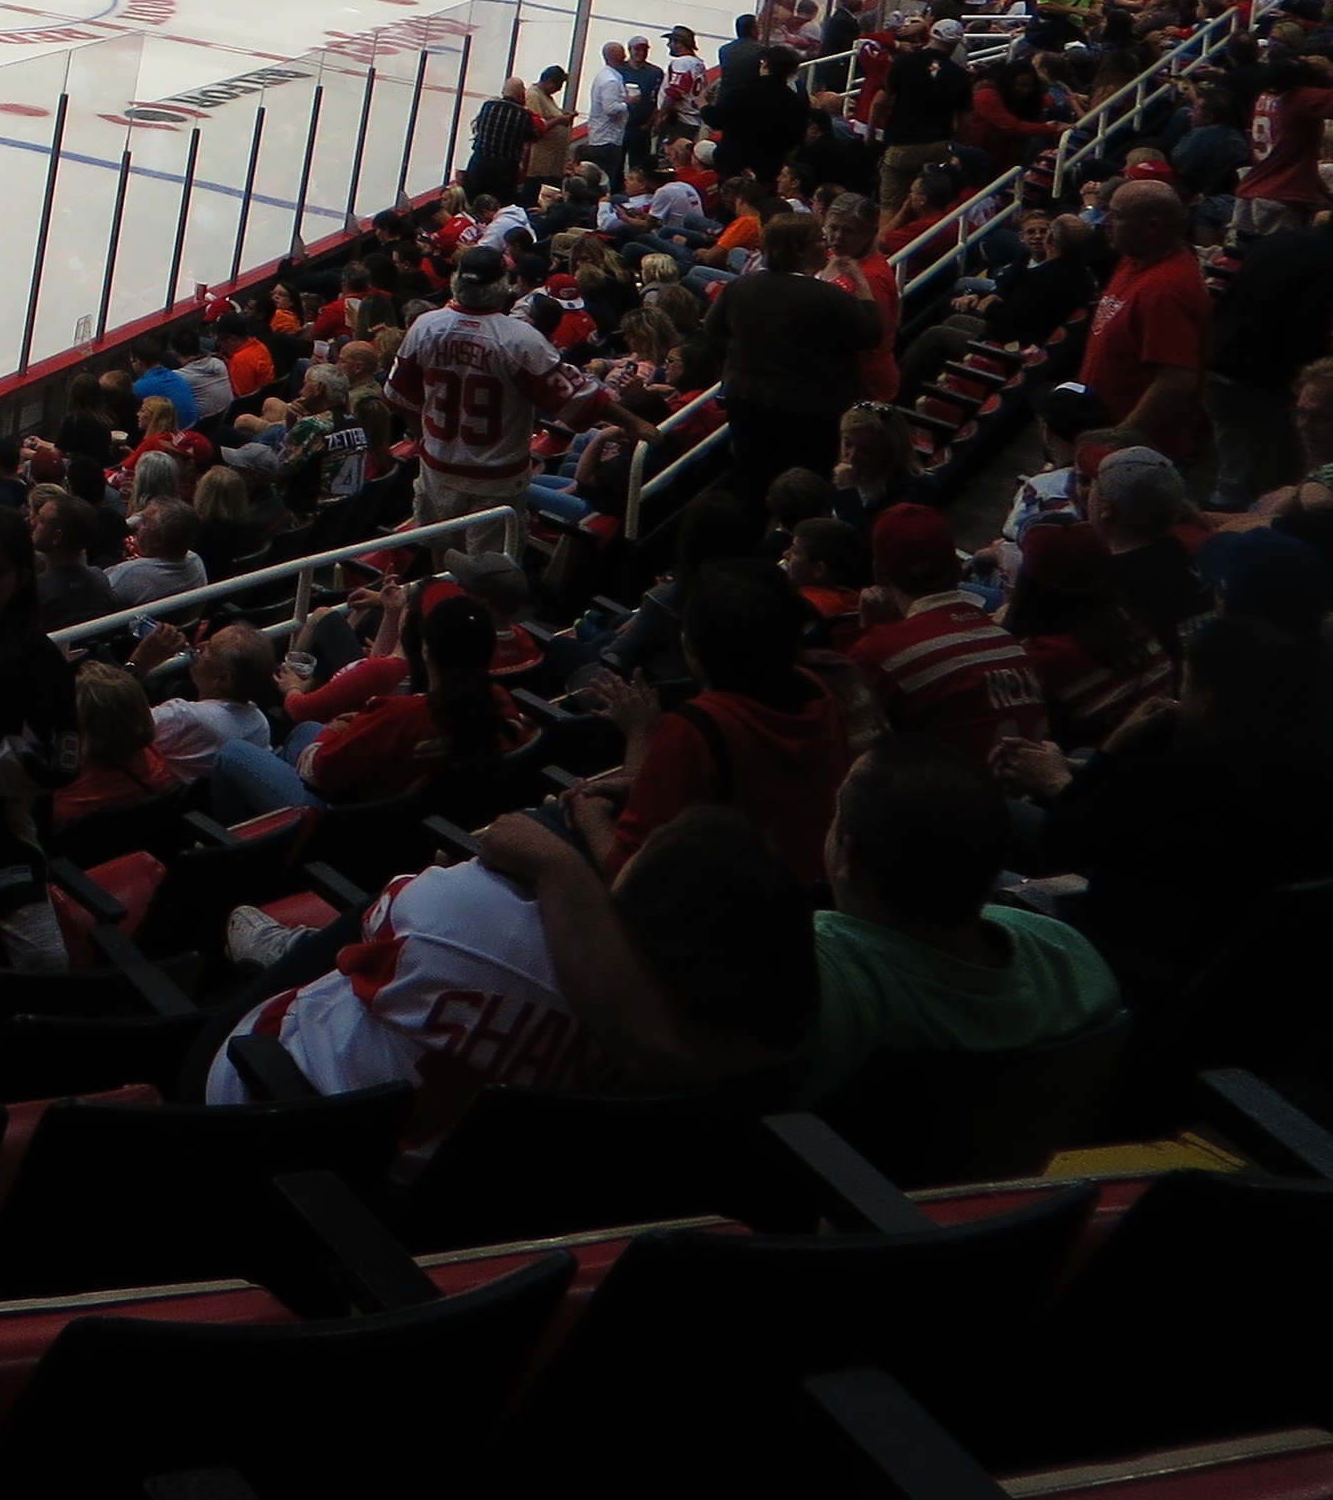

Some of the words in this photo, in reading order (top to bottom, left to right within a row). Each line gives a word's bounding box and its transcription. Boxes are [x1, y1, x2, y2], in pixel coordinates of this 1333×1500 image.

[435, 340, 492, 375] HASEK
[546, 364, 586, 399] 39
[424, 368, 504, 447] 39
